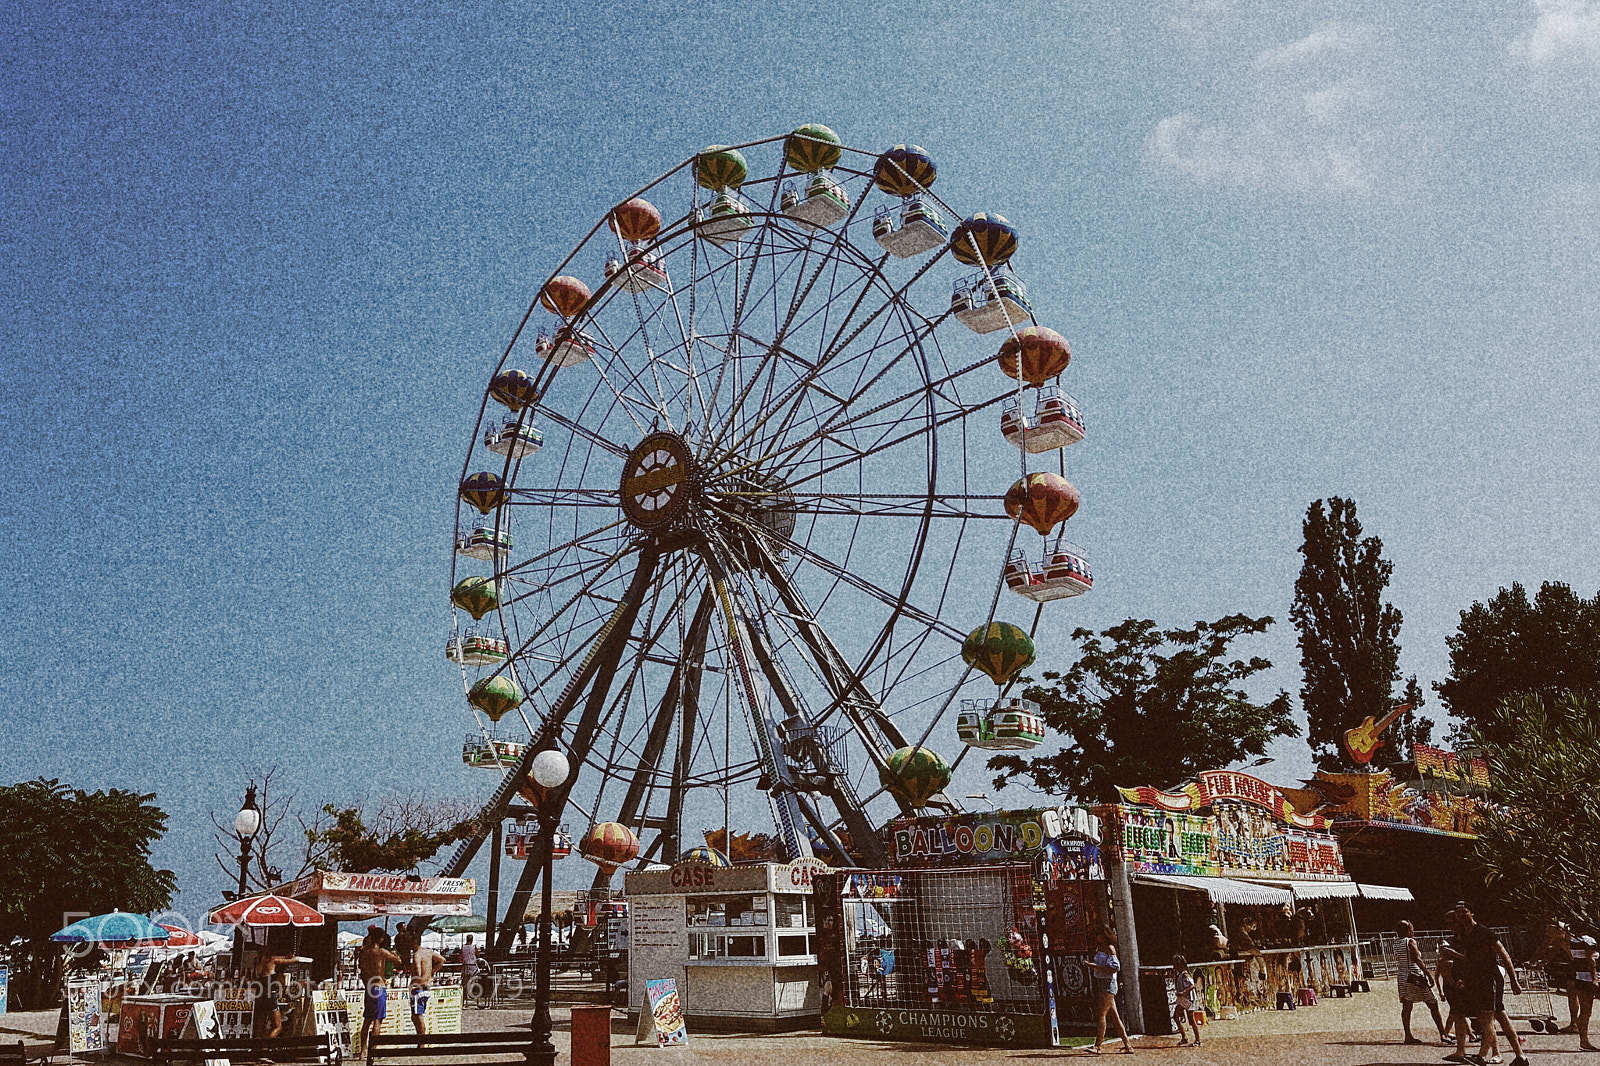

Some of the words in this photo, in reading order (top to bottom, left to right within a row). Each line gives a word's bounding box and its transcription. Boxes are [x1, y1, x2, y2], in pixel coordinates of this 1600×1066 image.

[1207, 775, 1233, 796] FUN
[1234, 775, 1273, 806] HOUSE
[1041, 805, 1102, 844] GOAL
[895, 823, 1013, 858] BALLOON
[1060, 839, 1086, 847] CHAMPIONS
[348, 875, 408, 891] PANCAKES
[670, 866, 715, 888] CASE
[225, 989, 245, 1000] ICE
[215, 1001, 253, 1011] CREAM
[314, 1000, 347, 1012] CREAM
[899, 1011, 988, 1029] CHAMPIONS
[921, 1026, 967, 1039] LEAGUE
